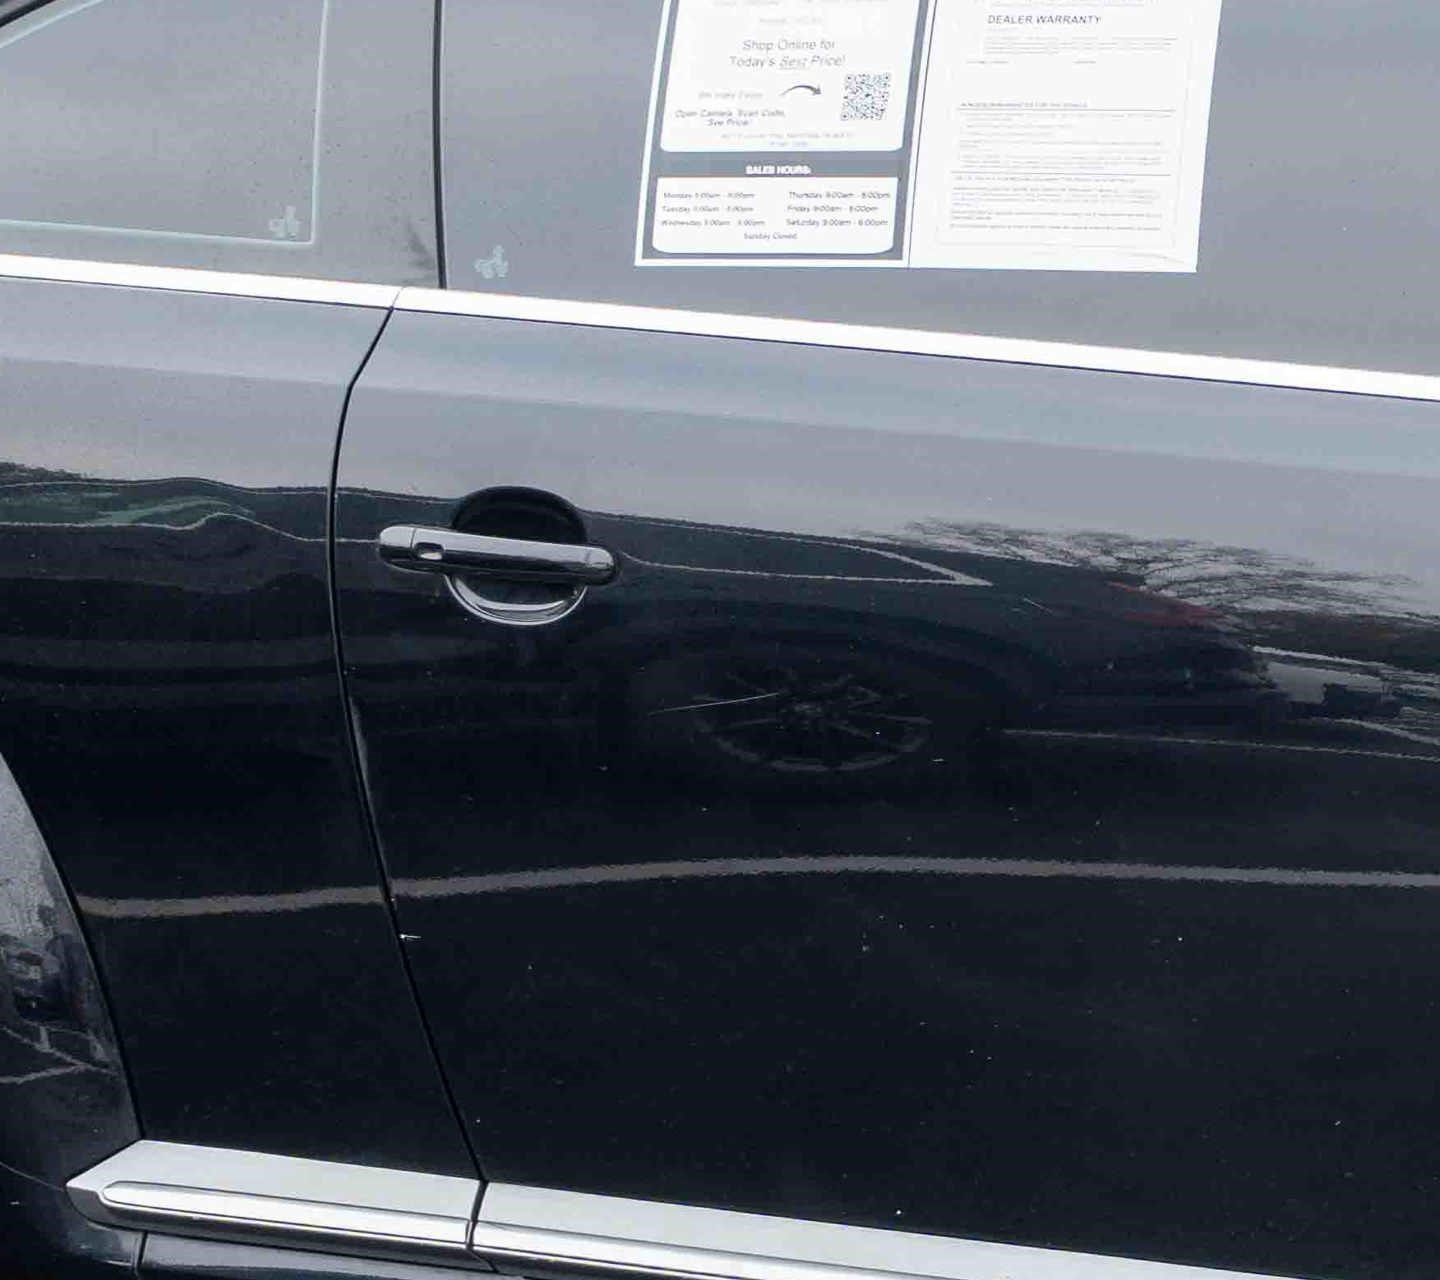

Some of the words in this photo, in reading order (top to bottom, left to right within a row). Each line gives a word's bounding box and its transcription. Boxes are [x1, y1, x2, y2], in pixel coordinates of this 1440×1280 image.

[986, 14, 1034, 25] DEALER
[1036, 14, 1102, 25] WARRANTY
[742, 39, 774, 52] Shop
[776, 38, 817, 51] Online
[729, 55, 776, 68] Today's
